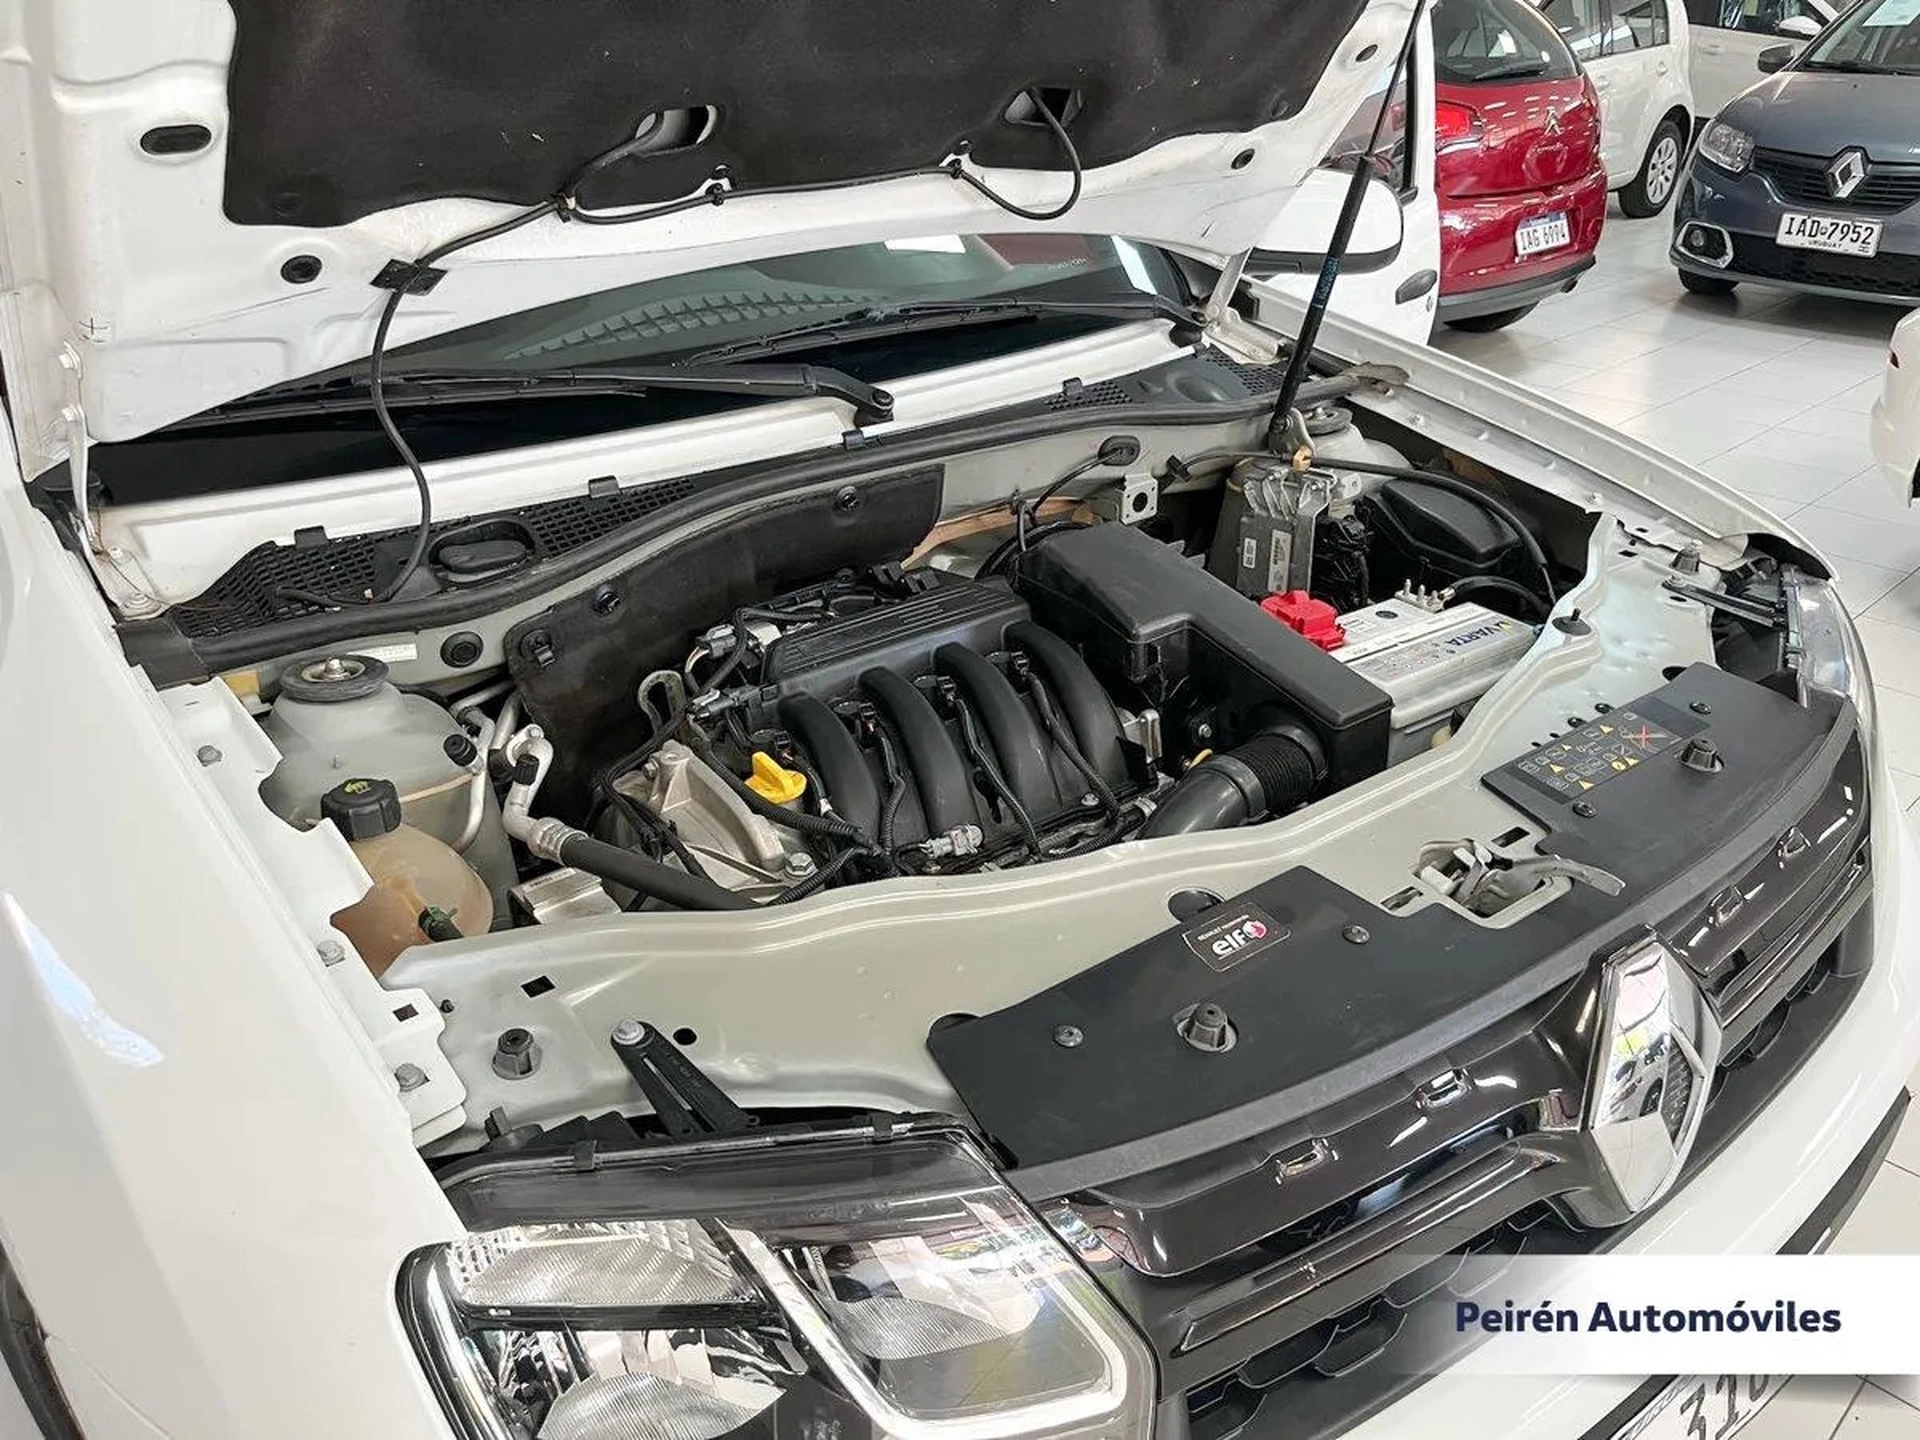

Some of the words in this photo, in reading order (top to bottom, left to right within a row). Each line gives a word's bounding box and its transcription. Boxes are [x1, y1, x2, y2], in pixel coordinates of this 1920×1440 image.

[1520, 228, 1540, 251] IAG
[1785, 217, 1820, 238] IAD
[1827, 222, 1874, 246] 7952
[1444, 626, 1501, 646] VARTA
